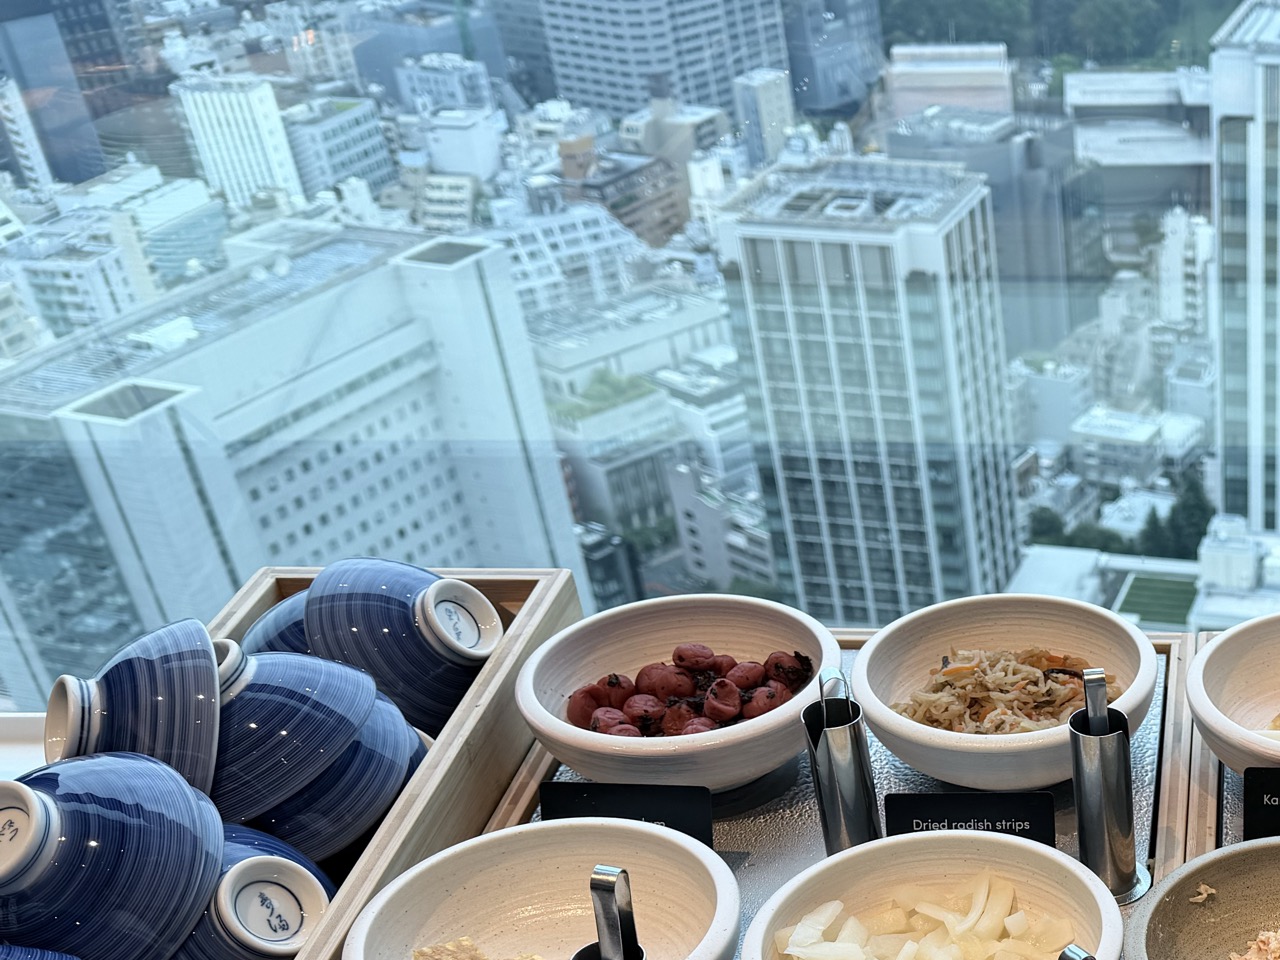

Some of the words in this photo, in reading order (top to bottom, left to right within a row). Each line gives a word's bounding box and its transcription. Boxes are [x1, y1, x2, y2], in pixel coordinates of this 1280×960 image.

[913, 819, 948, 830] Dried
[952, 819, 992, 830] radish
[996, 819, 1030, 832] strips
